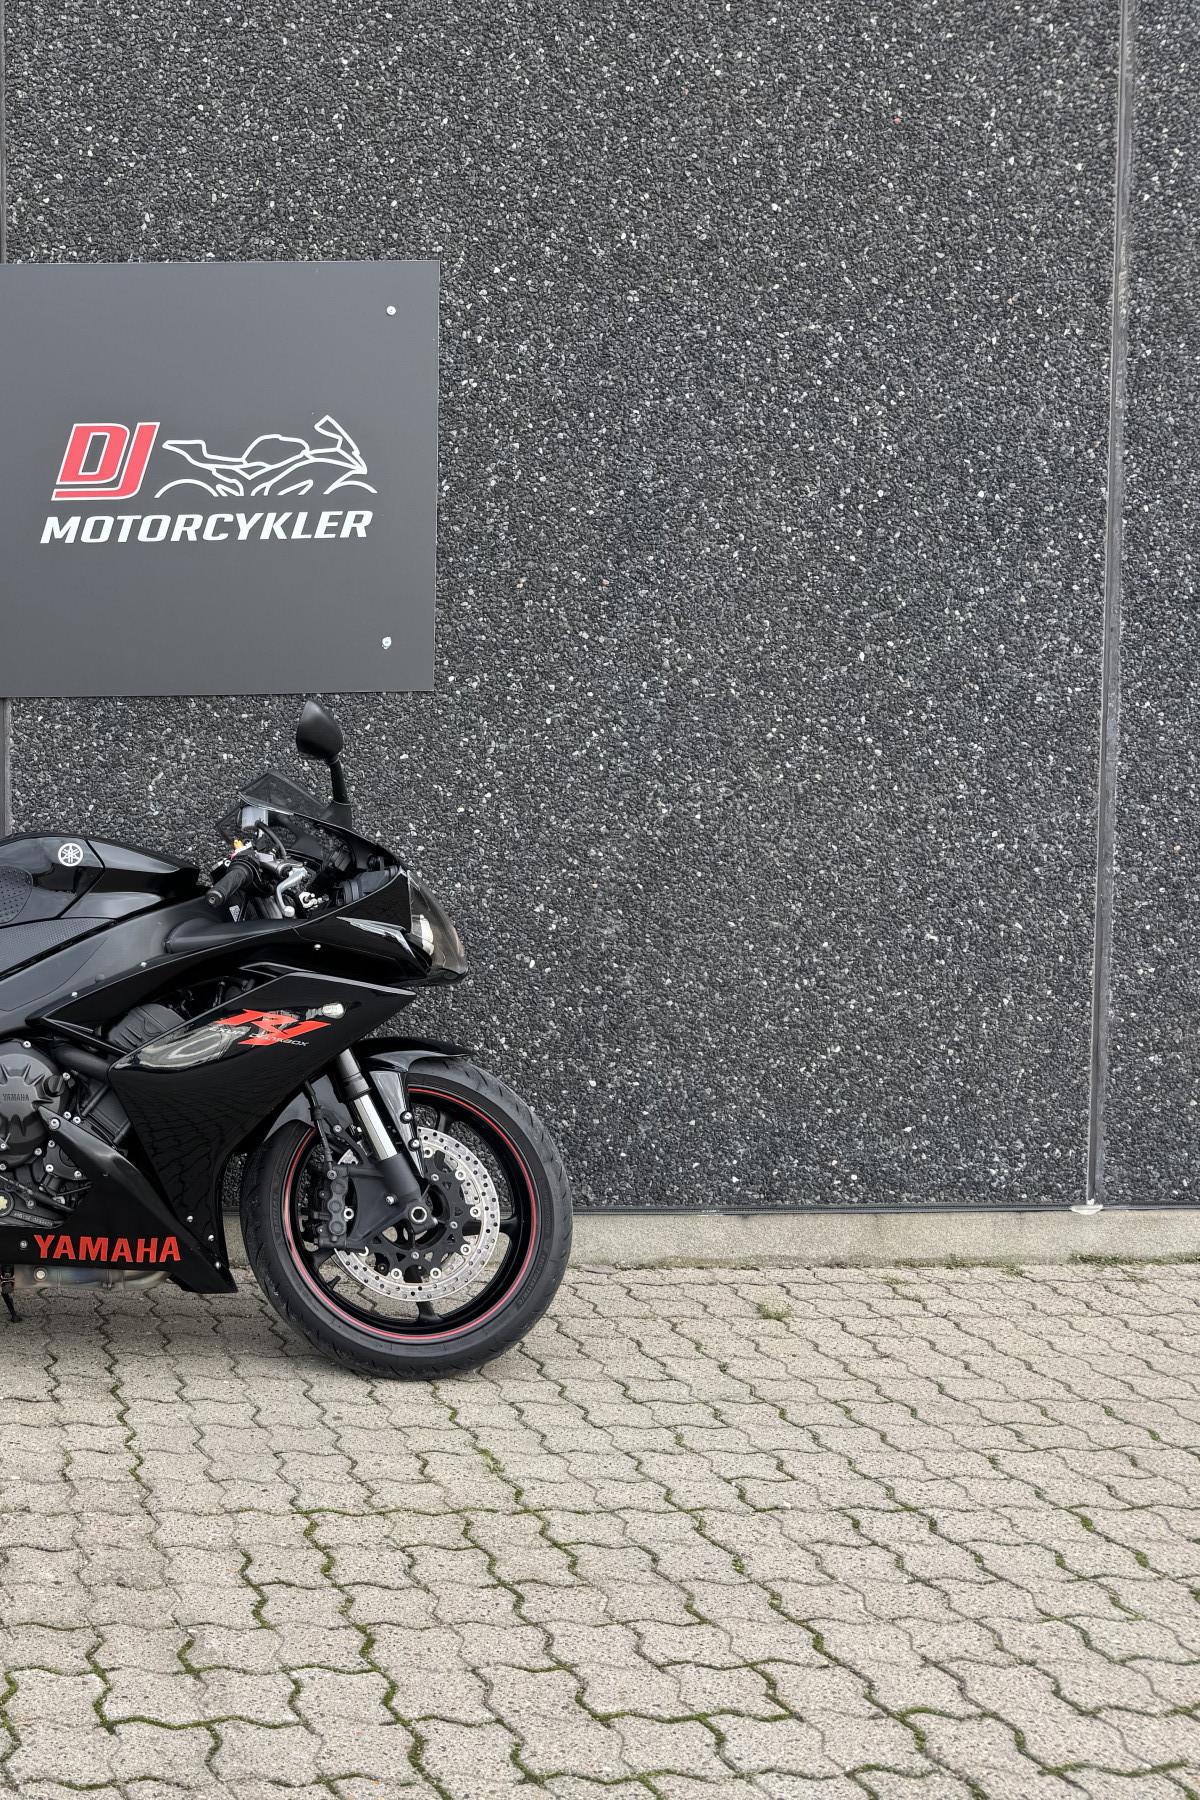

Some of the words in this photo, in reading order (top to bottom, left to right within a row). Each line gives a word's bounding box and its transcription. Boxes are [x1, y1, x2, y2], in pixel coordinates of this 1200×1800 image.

[51, 421, 161, 501] DJ
[39, 510, 373, 544] MOTORCYKLER
[2, 1092, 30, 1102] YAMAHA
[34, 1234, 181, 1263] YAMAHA
